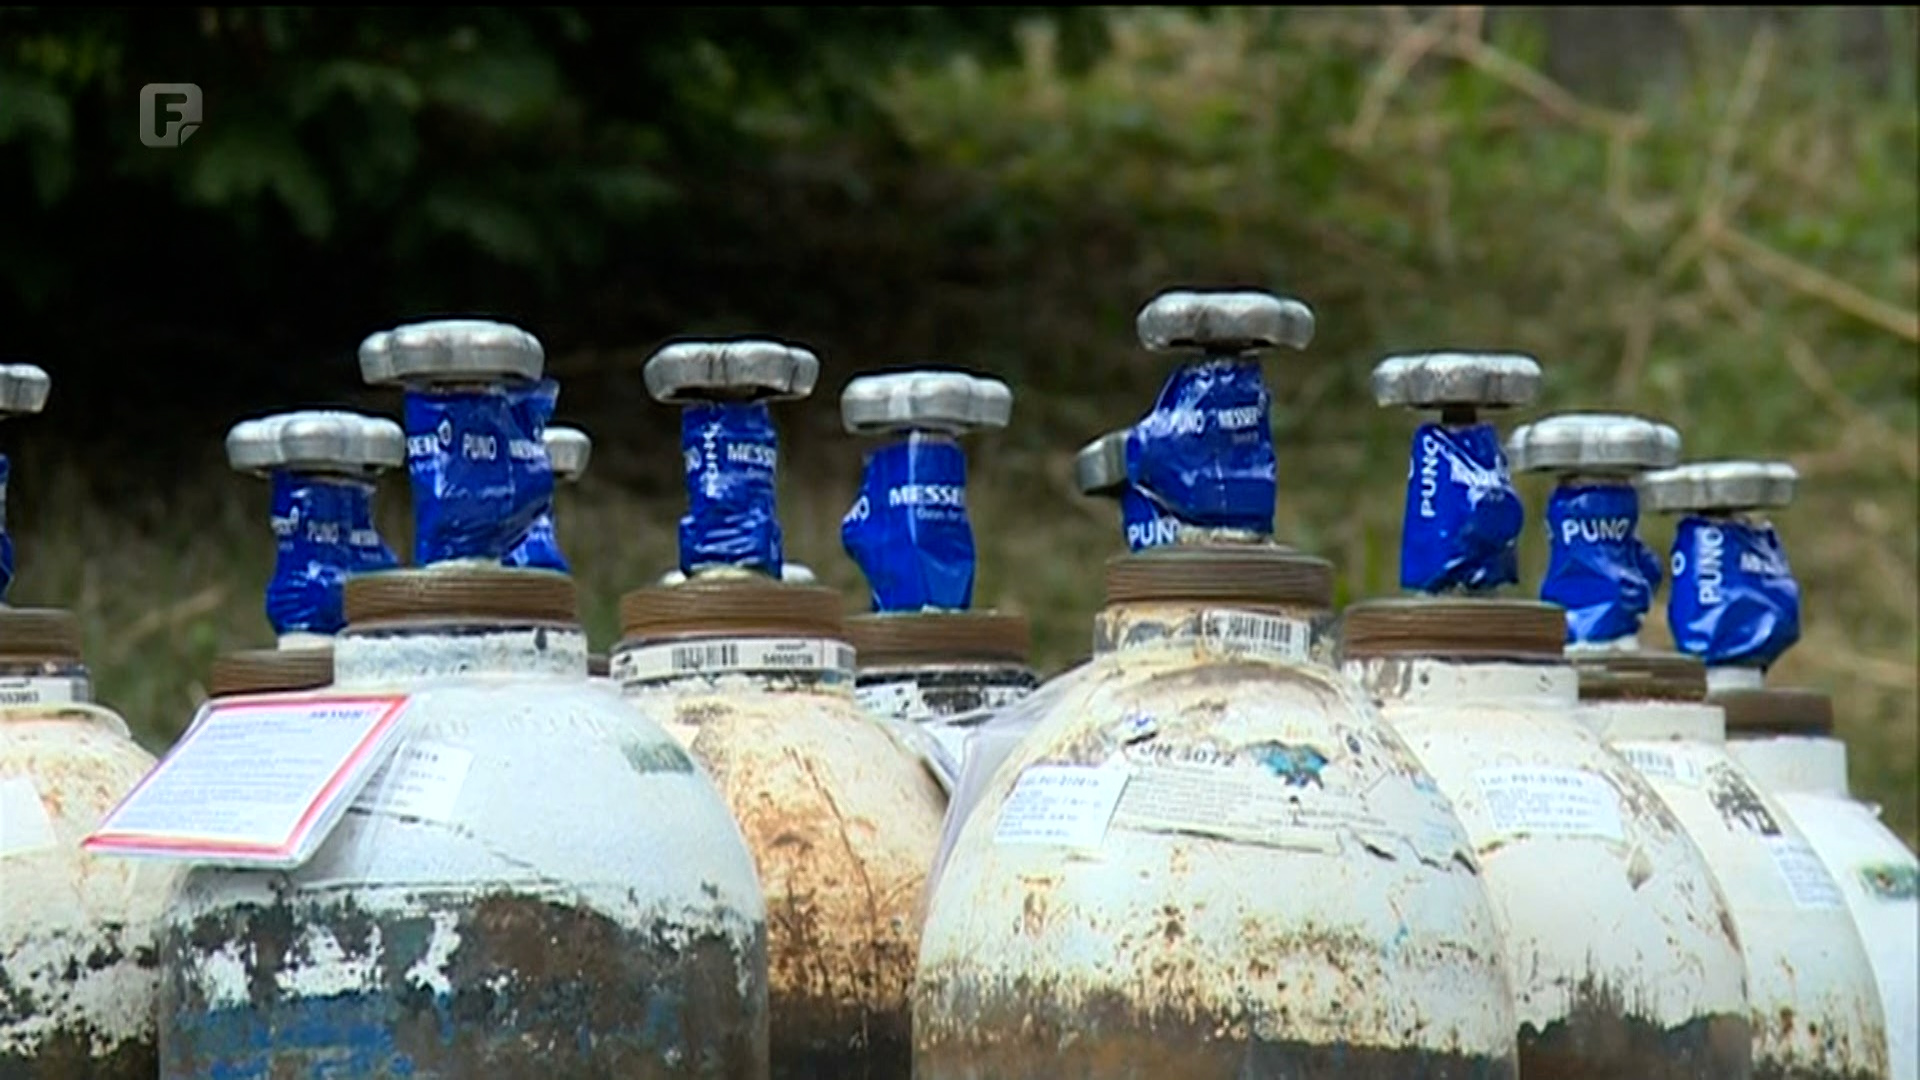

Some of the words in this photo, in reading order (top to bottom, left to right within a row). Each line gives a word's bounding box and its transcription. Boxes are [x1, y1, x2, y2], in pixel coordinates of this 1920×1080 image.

[462, 433, 498, 461] PUNO
[1420, 434, 1440, 518] PUNO
[1127, 514, 1179, 548] PUN
[1561, 517, 1631, 545] PUNO
[1698, 526, 1724, 605] PUNO
